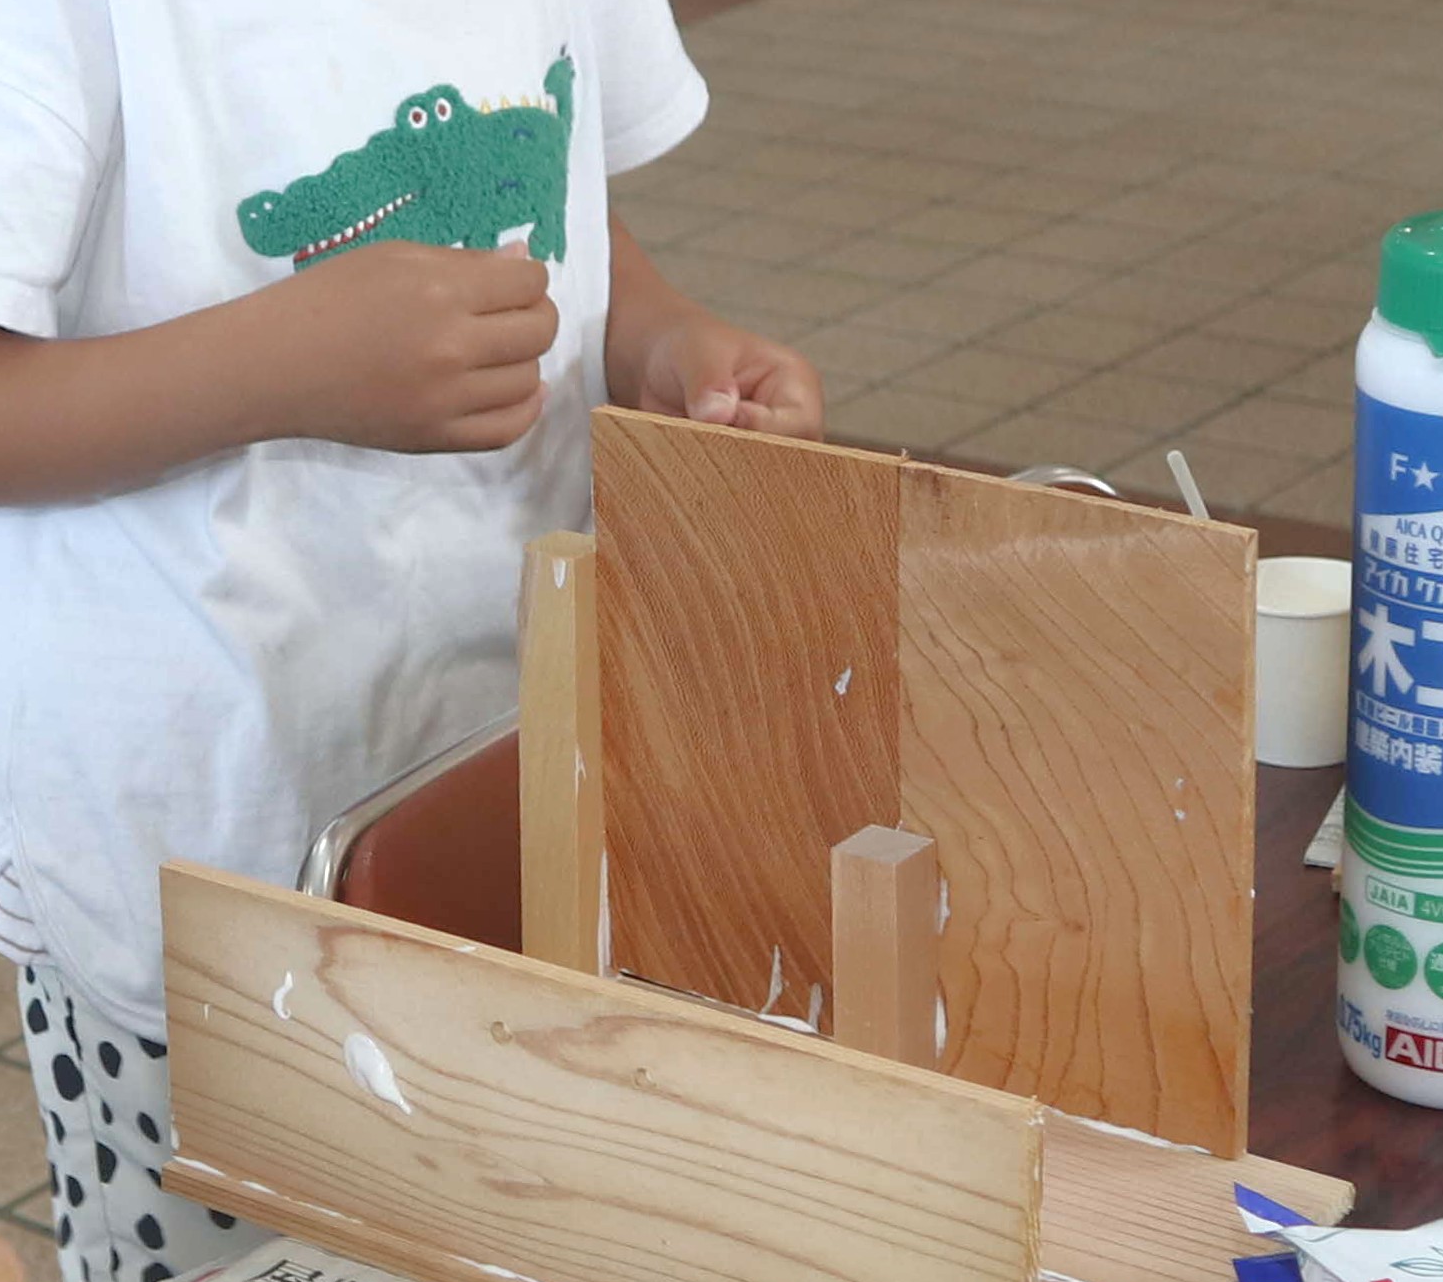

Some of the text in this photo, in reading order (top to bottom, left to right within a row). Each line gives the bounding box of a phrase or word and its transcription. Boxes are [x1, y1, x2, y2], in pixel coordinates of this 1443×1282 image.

[1396, 517, 1427, 540] AICA
[1365, 560, 1410, 598] アイカ
[1368, 882, 1410, 912] JAIA
